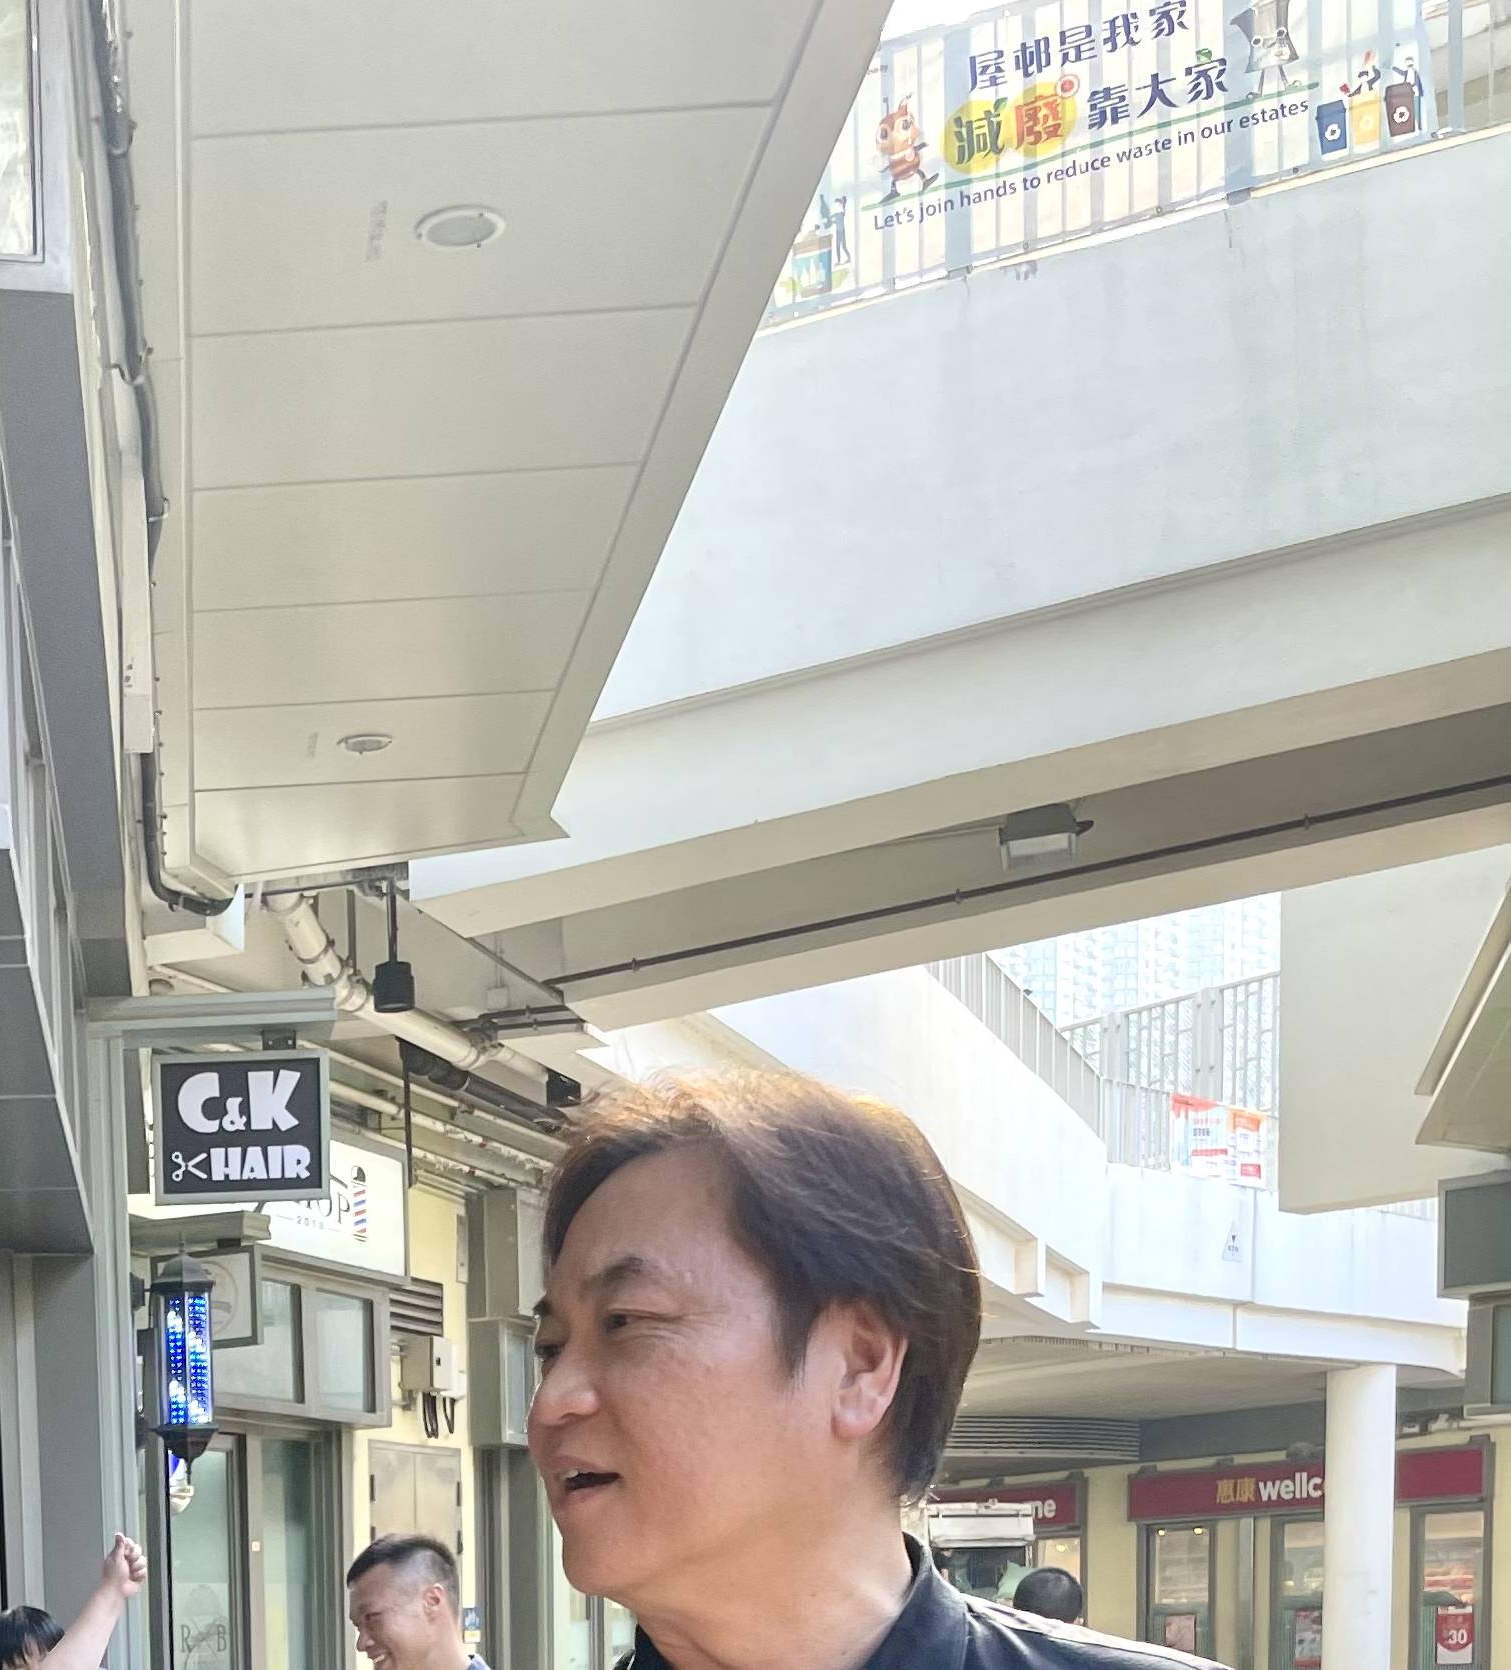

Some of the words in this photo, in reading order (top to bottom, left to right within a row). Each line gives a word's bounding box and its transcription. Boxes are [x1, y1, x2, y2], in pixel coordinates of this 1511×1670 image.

[969, 0, 1190, 94] 屋邨是我家
[873, 208, 915, 231] Let's
[918, 197, 955, 224] join
[959, 181, 1017, 208] hands
[1022, 174, 1042, 192] to
[1046, 155, 1111, 184] reduce
[1116, 136, 1173, 163] waste
[1177, 130, 1195, 147] in
[1200, 119, 1234, 140] our
[1238, 98, 1309, 130] estates
[177, 1068, 301, 1135] C&K
[209, 1143, 311, 1182] HAIR
[1257, 1471, 1325, 1502] wellc
